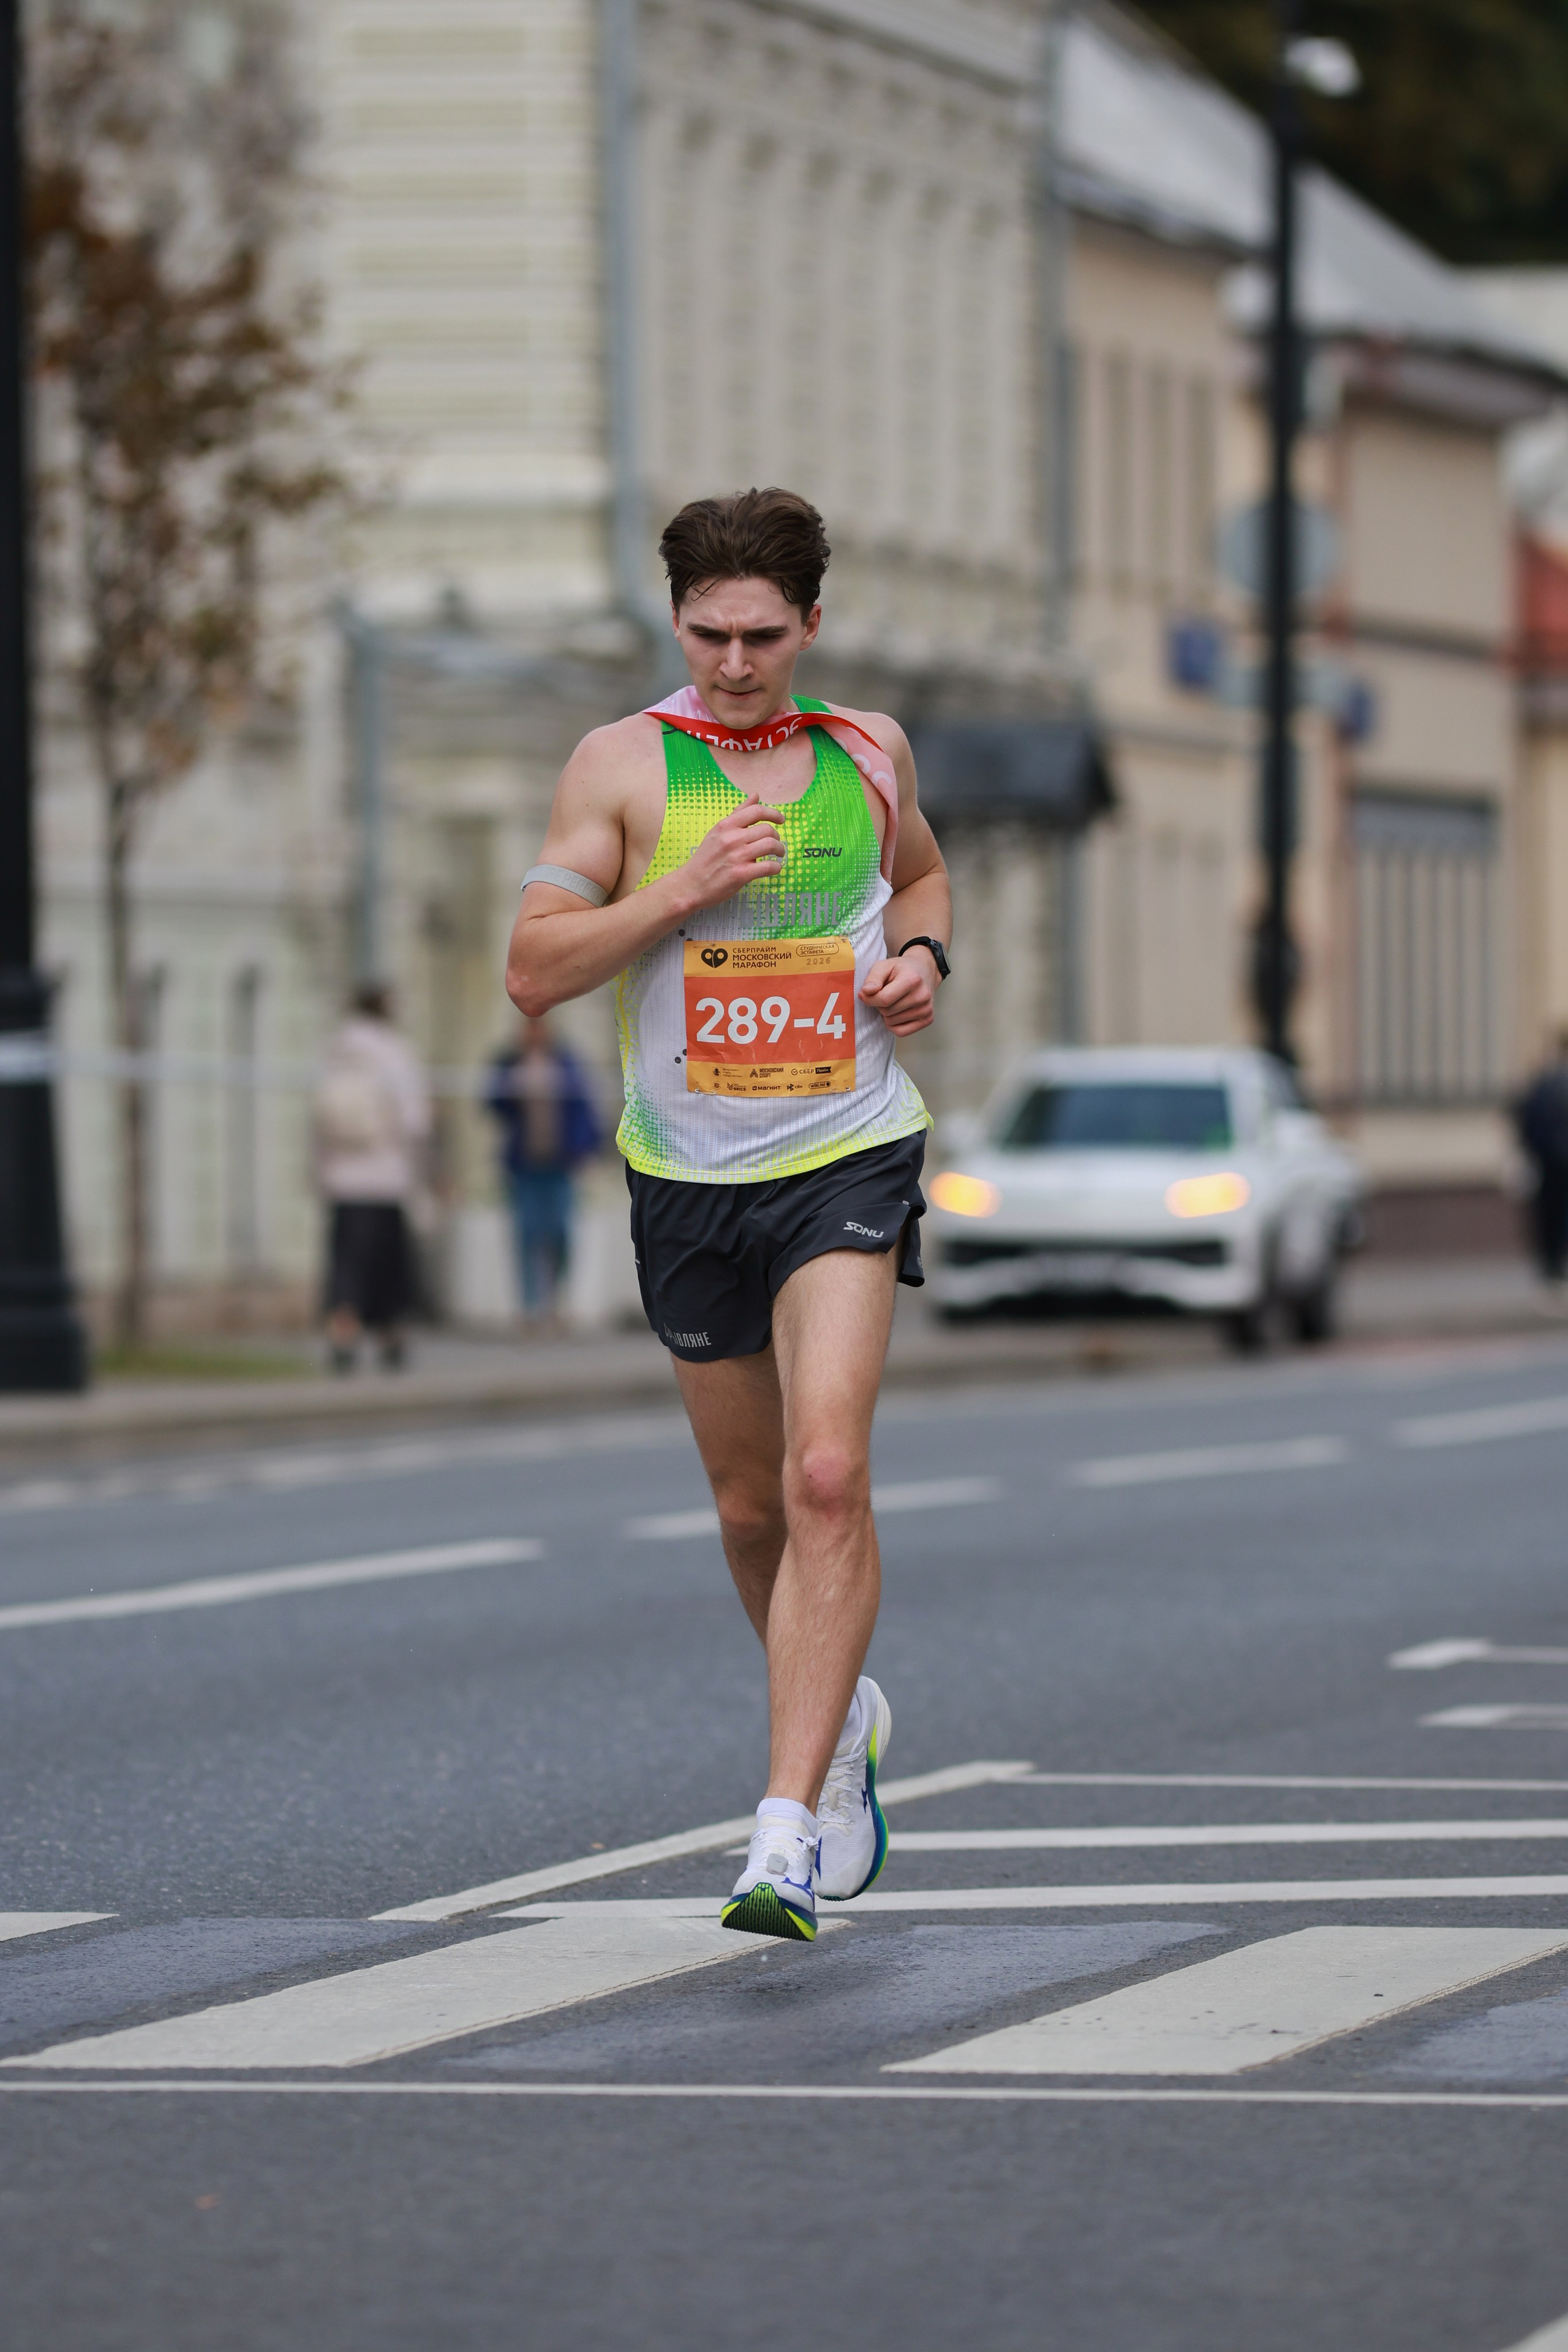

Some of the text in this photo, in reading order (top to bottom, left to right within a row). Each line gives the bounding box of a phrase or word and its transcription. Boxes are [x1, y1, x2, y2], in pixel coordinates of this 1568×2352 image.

[803, 847, 842, 858] SONU
[733, 951, 791, 961] МОСКОВСКИЙ
[806, 957, 831, 965] 2026
[696, 992, 846, 1044] 289-4
[843, 1221, 884, 1238] SONU
